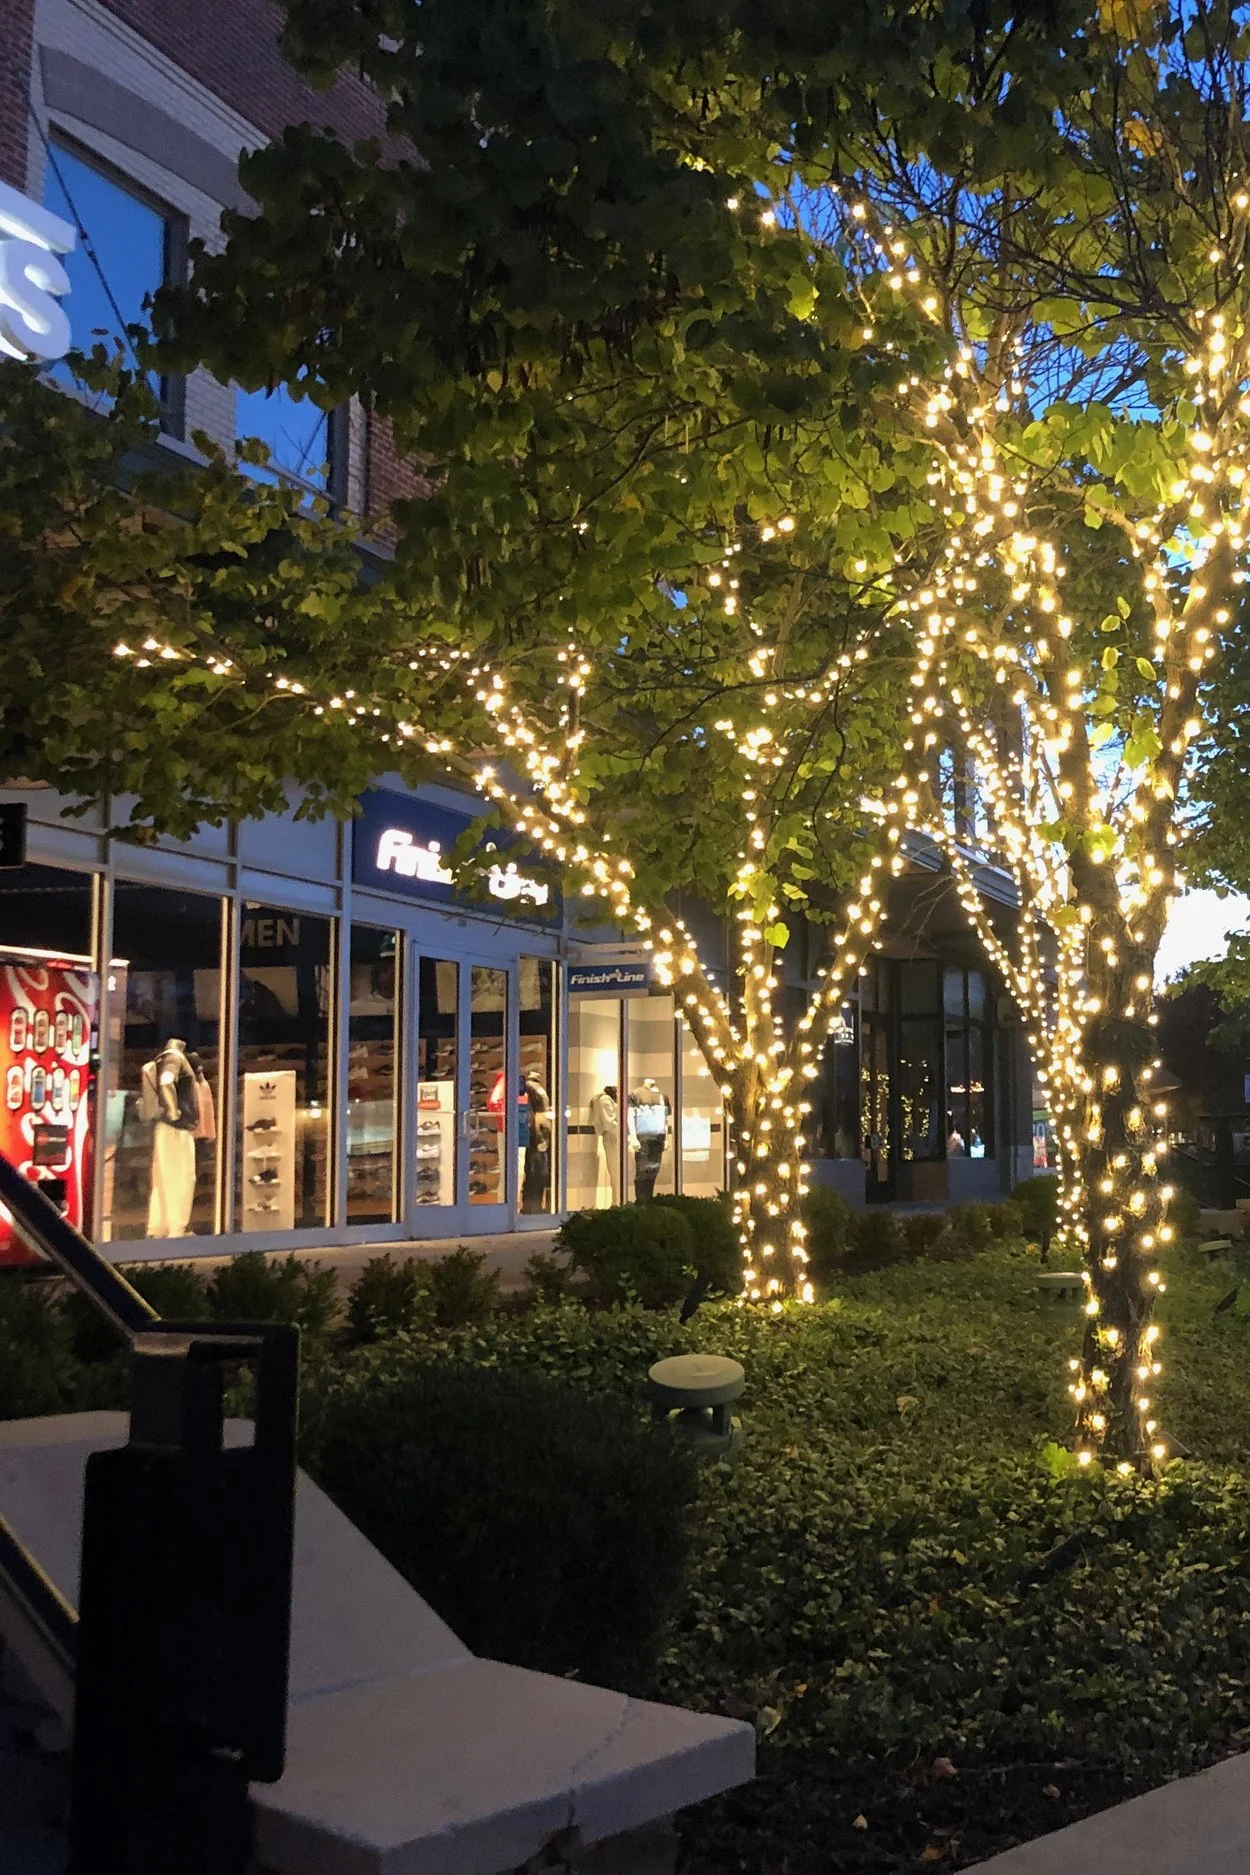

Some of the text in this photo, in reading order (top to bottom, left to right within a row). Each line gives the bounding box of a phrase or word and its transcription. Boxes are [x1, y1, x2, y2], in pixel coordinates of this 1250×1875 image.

[377, 828, 453, 885] Fini
[570, 971, 645, 985] Finish Line
